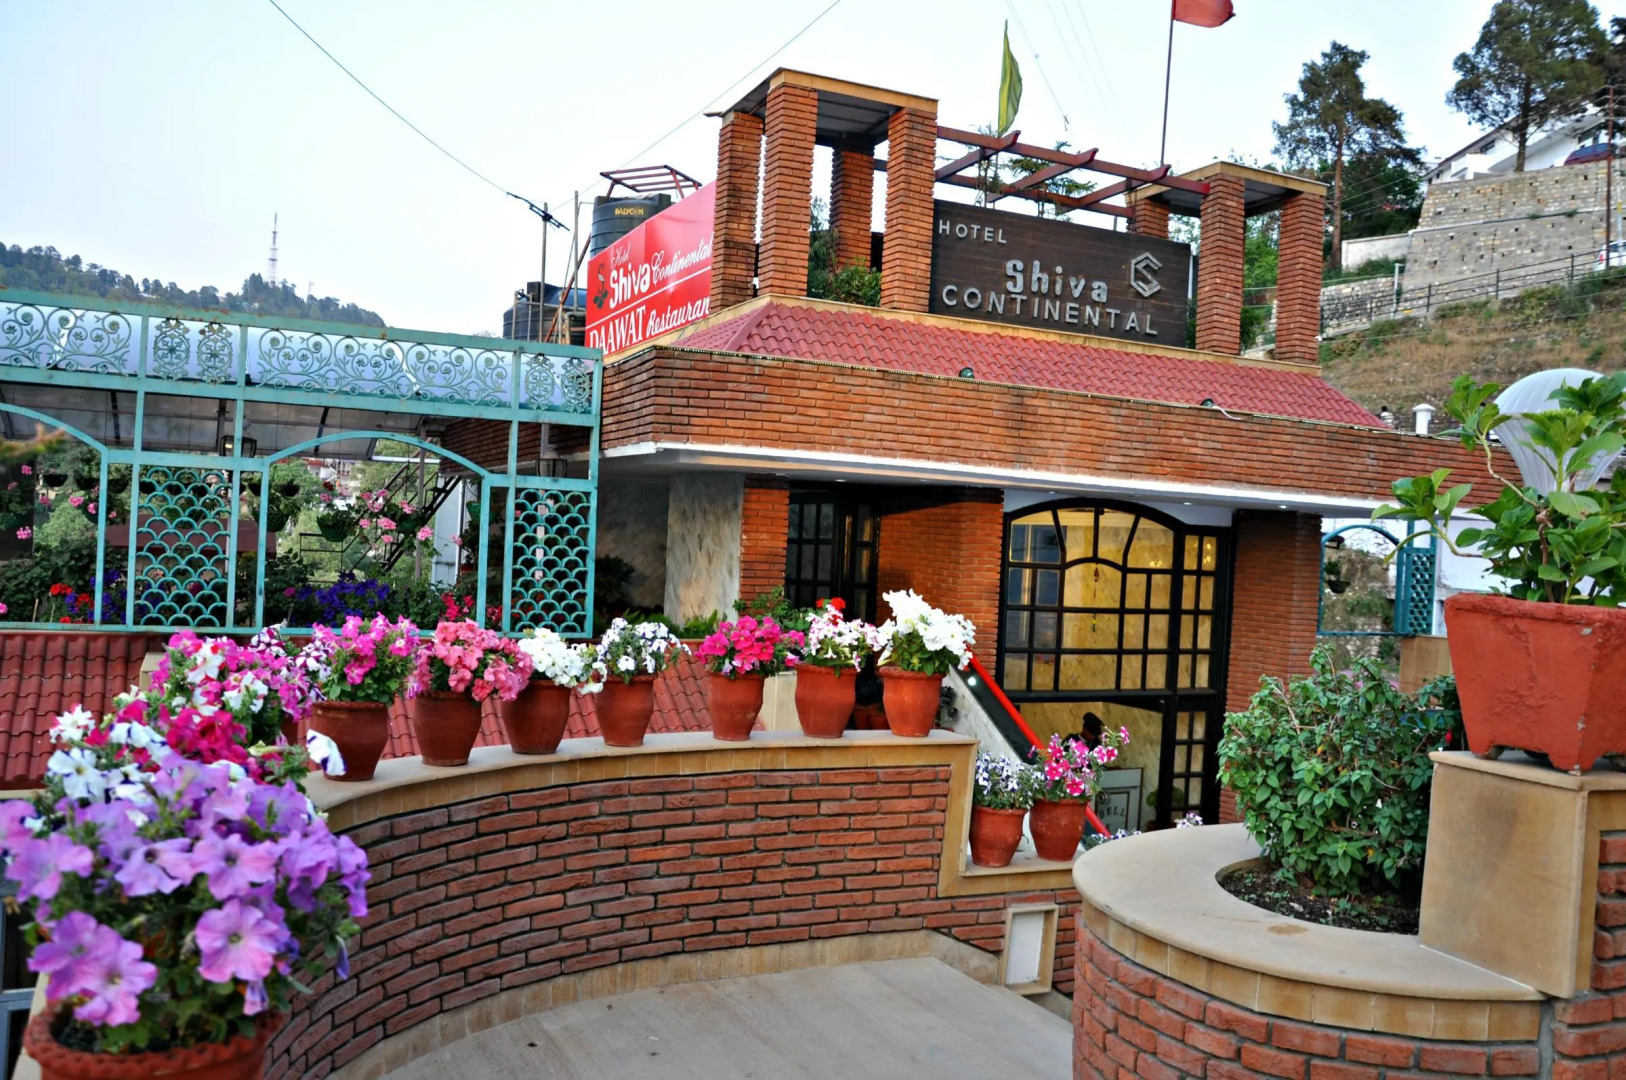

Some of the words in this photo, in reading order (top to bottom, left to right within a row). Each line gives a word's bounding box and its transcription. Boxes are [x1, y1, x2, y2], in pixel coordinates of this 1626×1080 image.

[938, 218, 1007, 244] HOTEL
[609, 262, 651, 309] Shiva
[651, 234, 714, 287] Continental
[1005, 259, 1108, 303] Shiva
[589, 305, 646, 356] DAAWAT
[646, 297, 711, 338] Restauran
[942, 284, 1158, 335] CONTINENTAL
[1100, 806, 1125, 819] BELL
